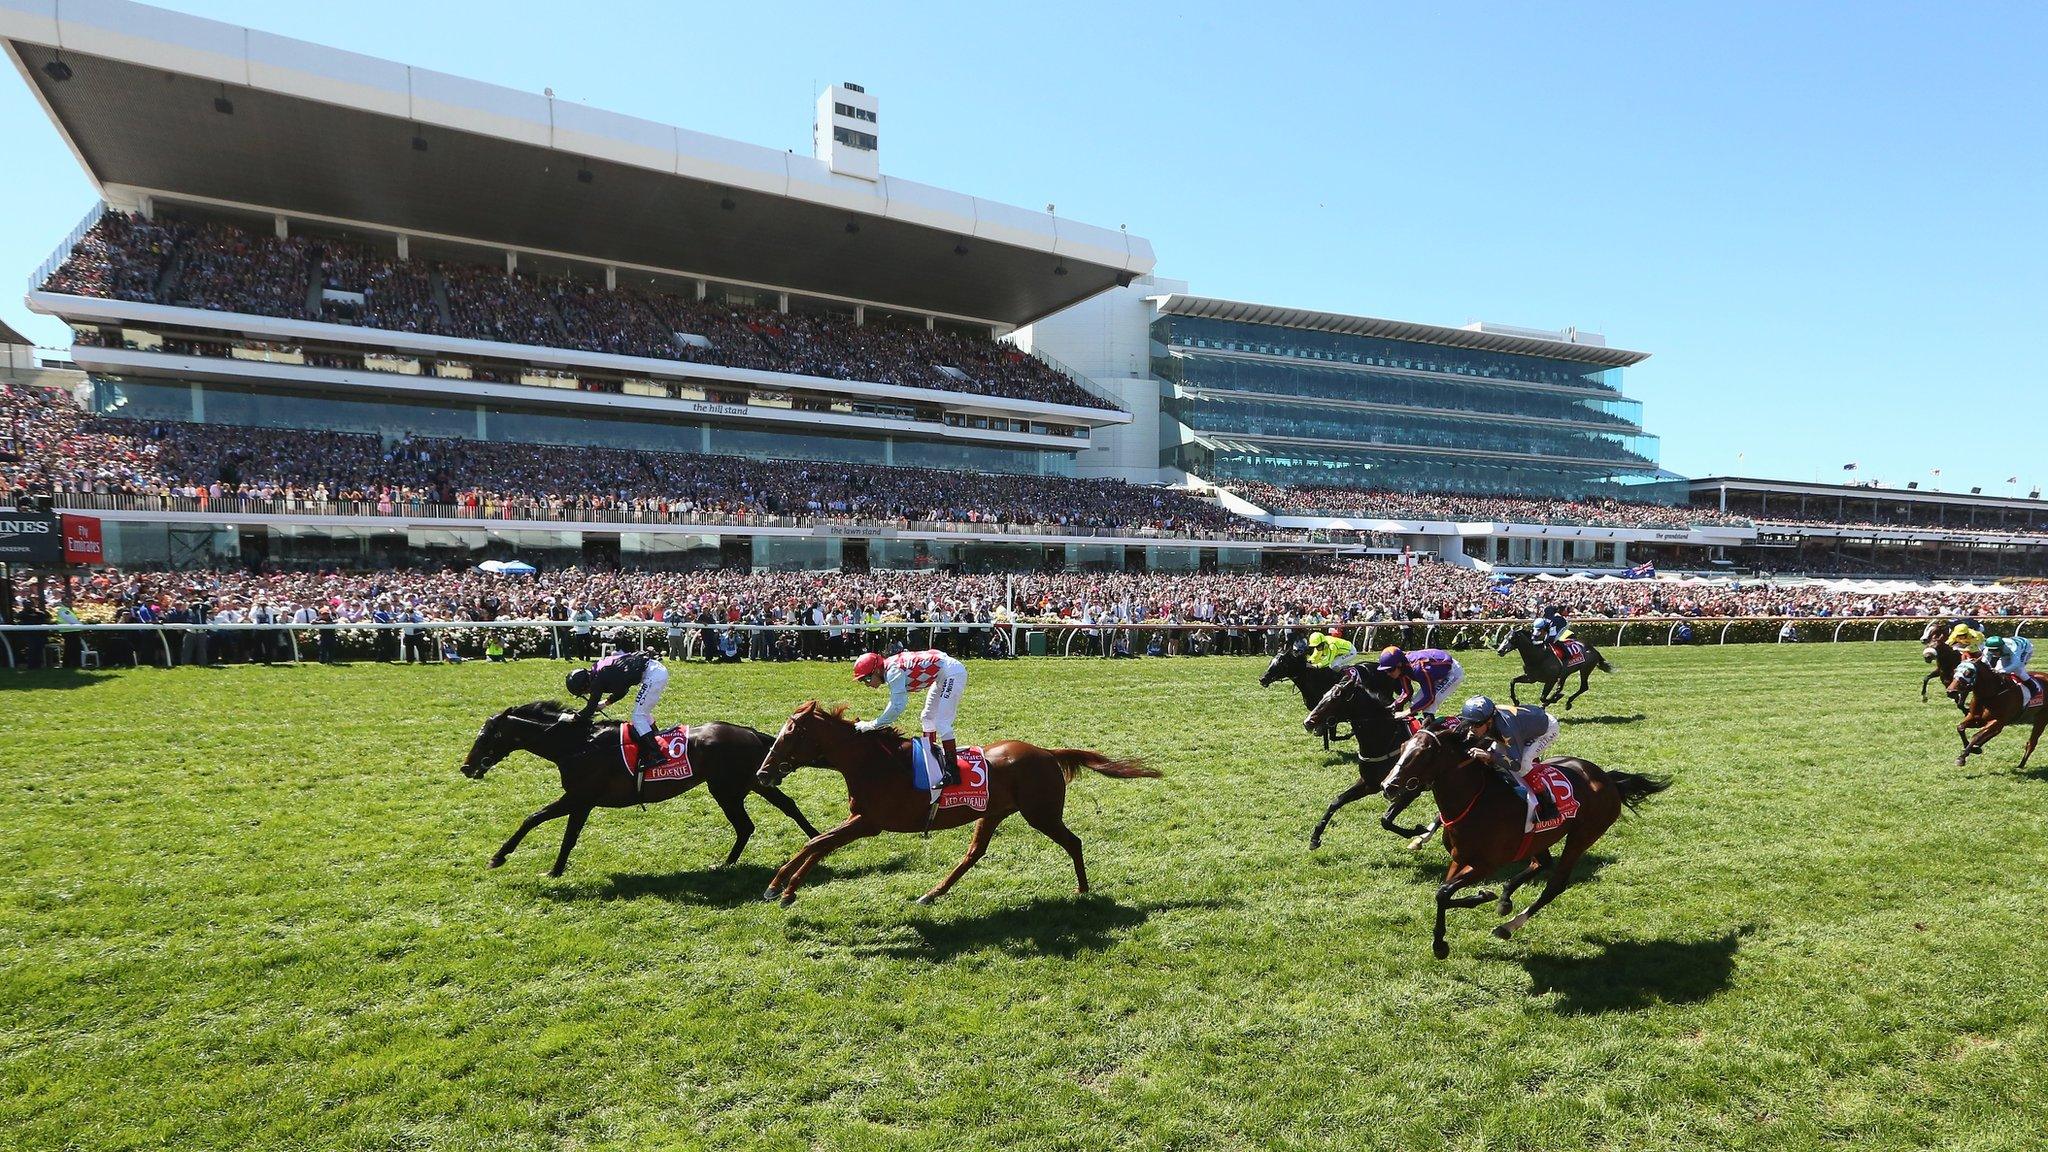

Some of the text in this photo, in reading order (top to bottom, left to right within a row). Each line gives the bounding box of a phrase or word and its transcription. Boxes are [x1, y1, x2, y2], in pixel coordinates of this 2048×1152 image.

[693, 403, 748, 415] the hill stand
[78, 525, 89, 538] Fly
[843, 527, 861, 535] lawn
[68, 537, 100, 552] Emirates
[1567, 643, 1580, 656] 10
[668, 736, 685, 759] 6
[968, 760, 986, 787] 3
[1541, 772, 1572, 803] 15
[945, 797, 958, 806] RED
